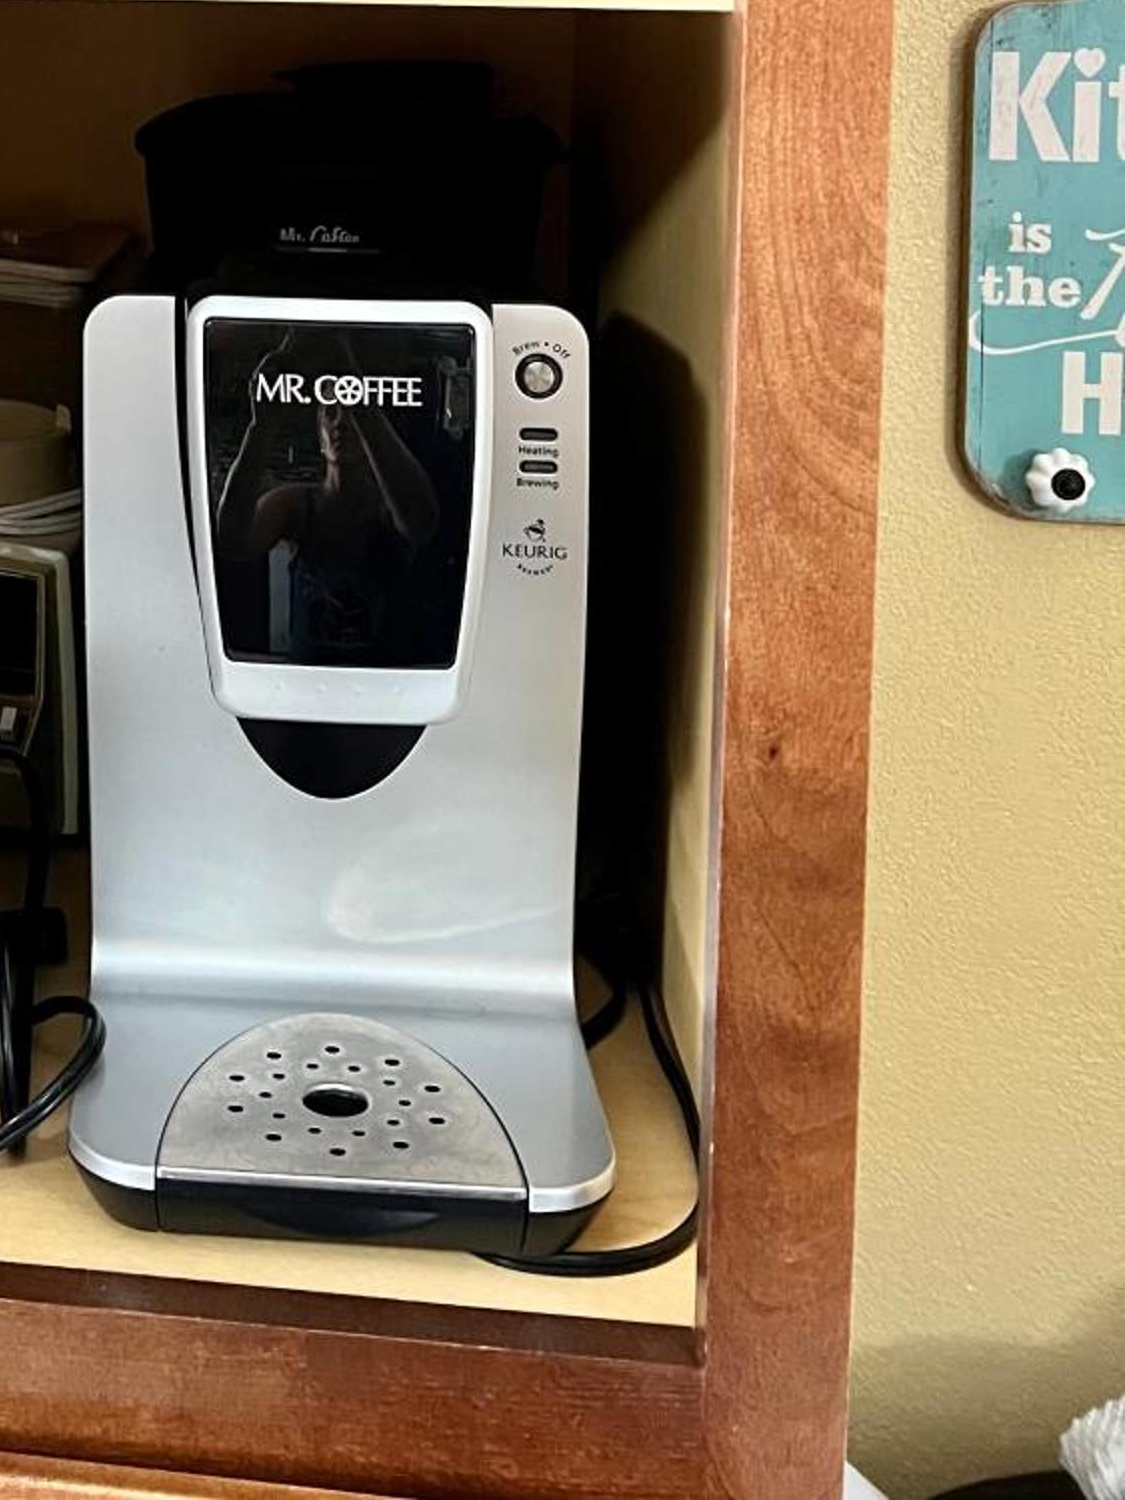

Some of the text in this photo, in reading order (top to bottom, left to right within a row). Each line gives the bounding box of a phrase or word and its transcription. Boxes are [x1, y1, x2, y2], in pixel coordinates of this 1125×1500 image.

[1008, 211, 1052, 254] is
[978, 265, 1083, 308] the
[552, 343, 571, 359] Off
[256, 373, 423, 407] MR. COFFEE
[518, 445, 559, 459] Heating
[516, 477, 560, 491] Brewing
[502, 543, 568, 560] KEURIG
